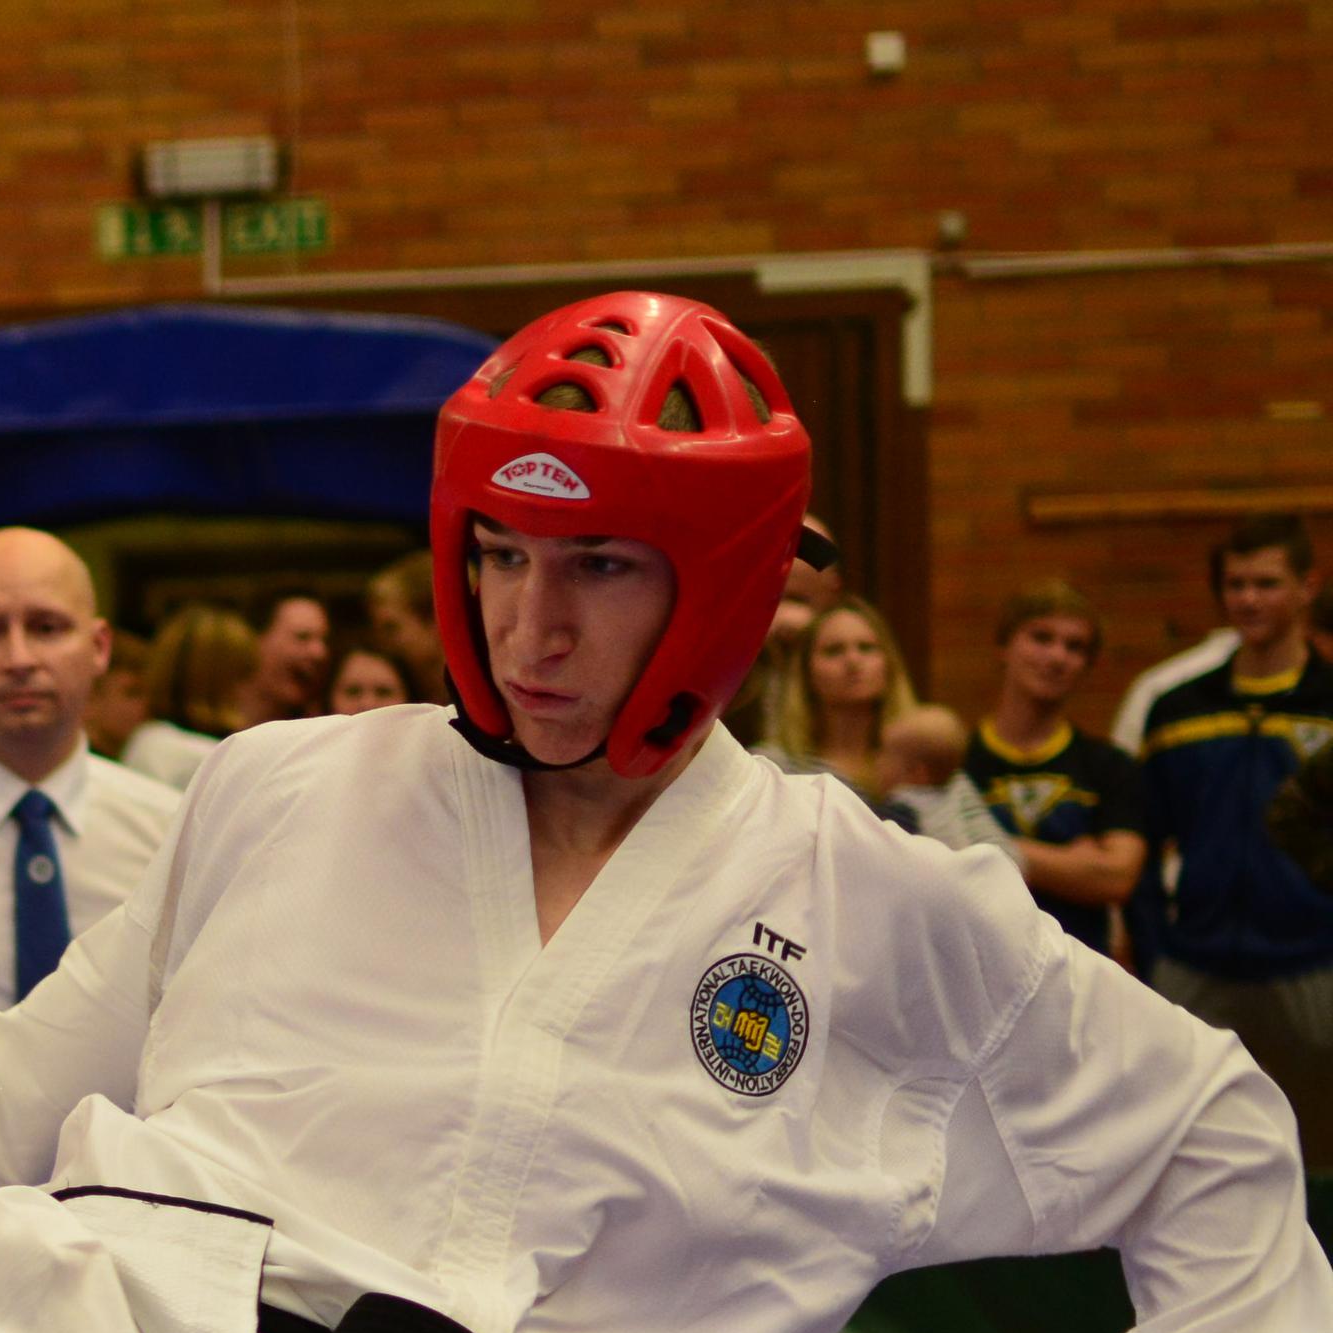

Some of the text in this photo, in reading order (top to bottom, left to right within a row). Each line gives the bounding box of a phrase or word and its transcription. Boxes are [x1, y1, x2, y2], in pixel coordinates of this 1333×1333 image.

[500, 461, 580, 492] TOP TEN
[752, 921, 807, 962] ITF
[695, 958, 805, 1092] INTERNATIONAL TAEKWON-DO FEDERATION
